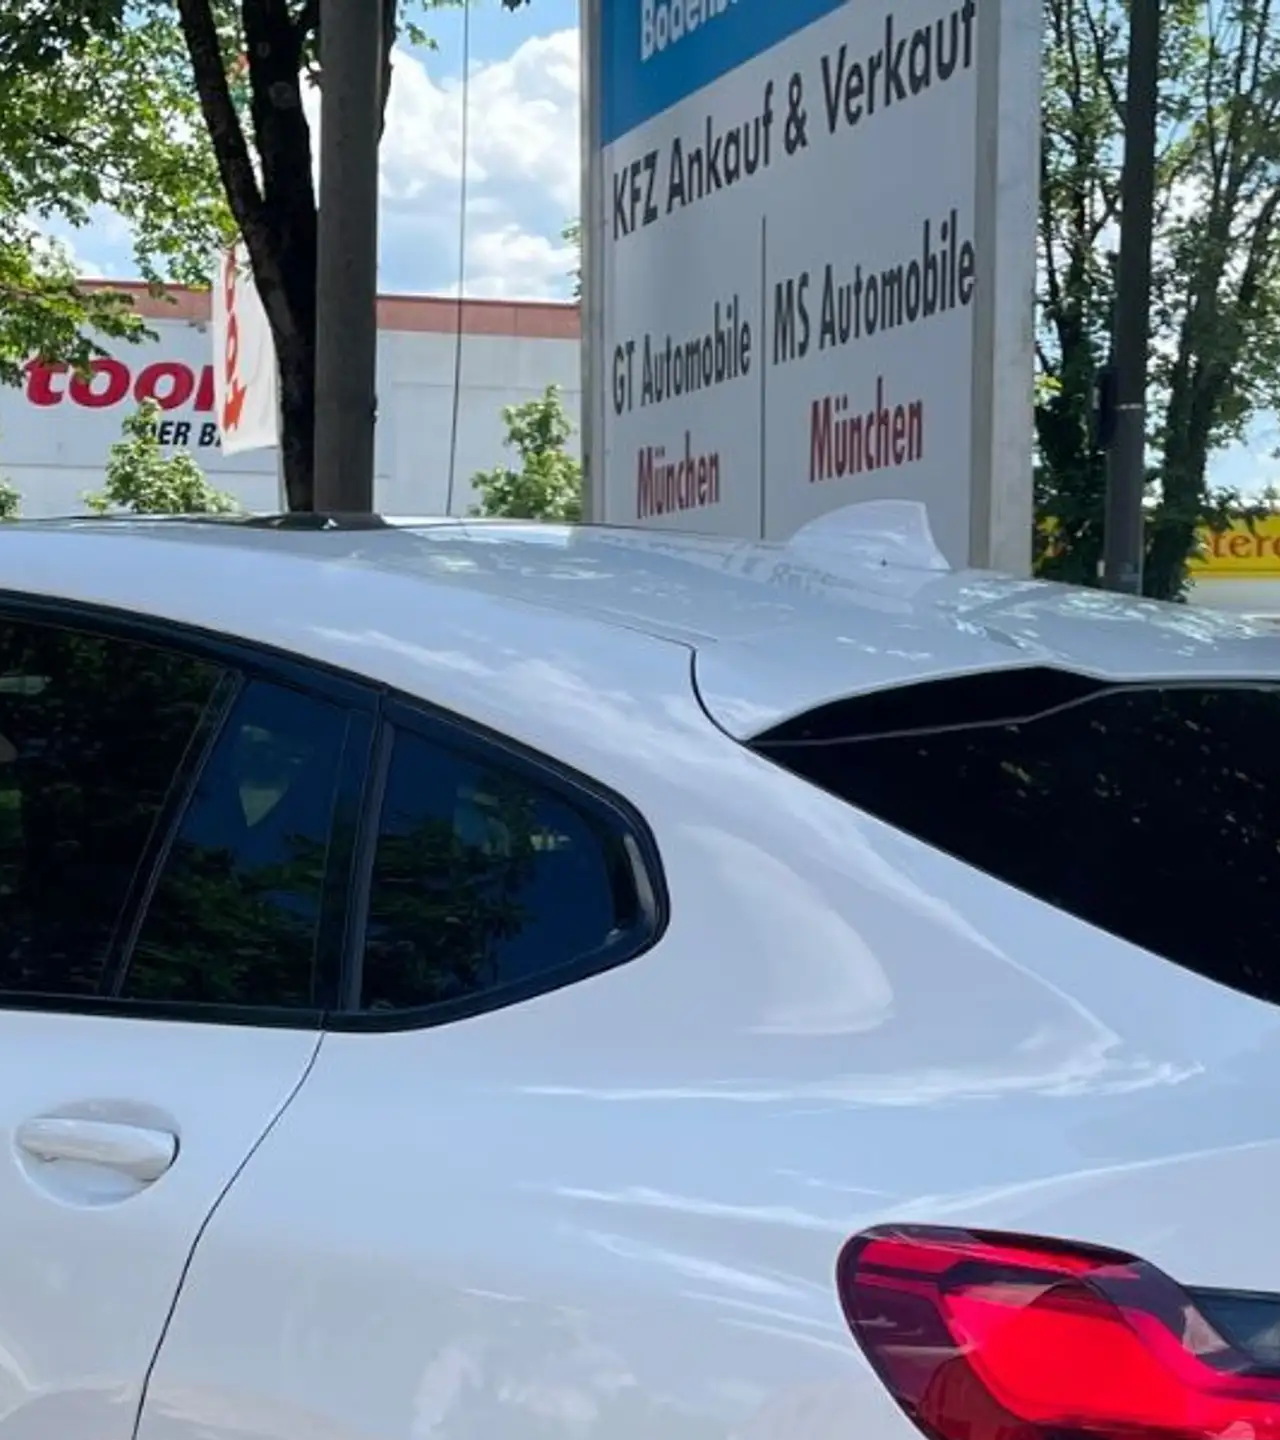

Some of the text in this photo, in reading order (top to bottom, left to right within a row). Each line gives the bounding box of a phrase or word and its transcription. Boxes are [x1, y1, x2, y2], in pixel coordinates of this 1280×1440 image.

[612, 2, 976, 240] KFZ Ankauf & Verkauf
[773, 209, 976, 365] MS Automobile
[612, 295, 751, 416] GT Automobile
[637, 431, 719, 519] München
[809, 377, 923, 482] München
